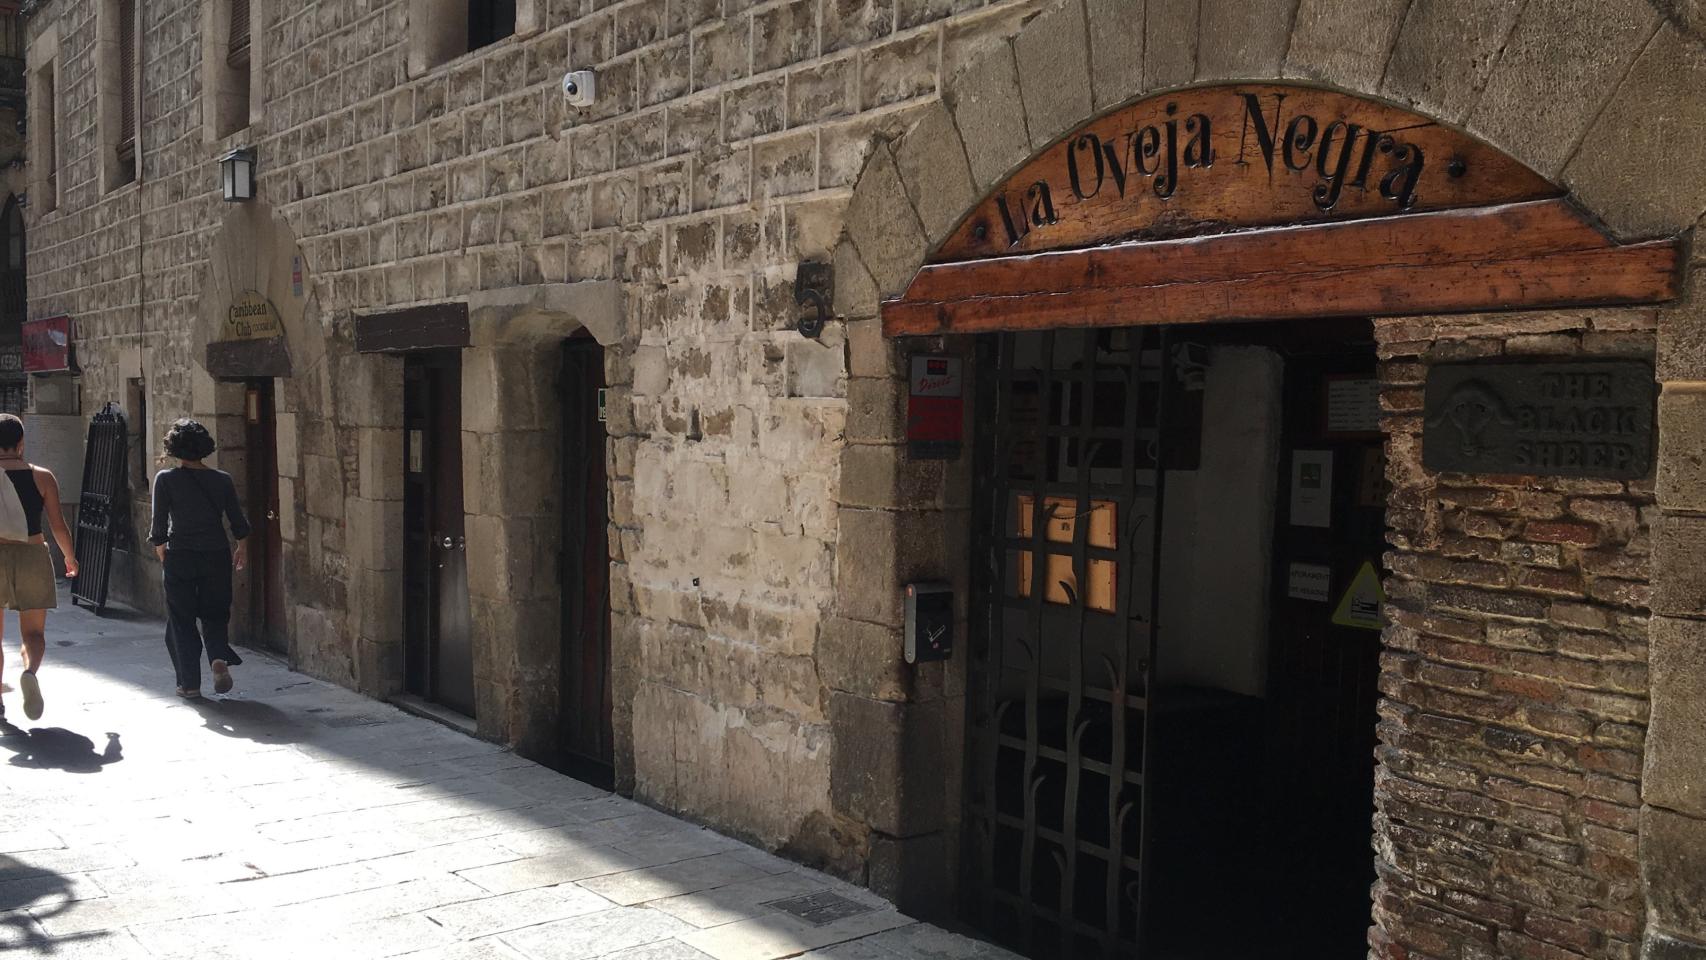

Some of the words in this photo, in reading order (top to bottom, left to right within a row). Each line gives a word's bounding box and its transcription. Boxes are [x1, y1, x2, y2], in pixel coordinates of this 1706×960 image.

[998, 180, 1060, 248] La
[1066, 102, 1216, 201] Oveja
[1235, 92, 1426, 212] Negra
[228, 300, 267, 325] Caribbean
[235, 320, 252, 337] Club
[1540, 371, 1613, 400] THE
[1515, 404, 1638, 434] BLACK
[1513, 439, 1633, 470] SHEEP
